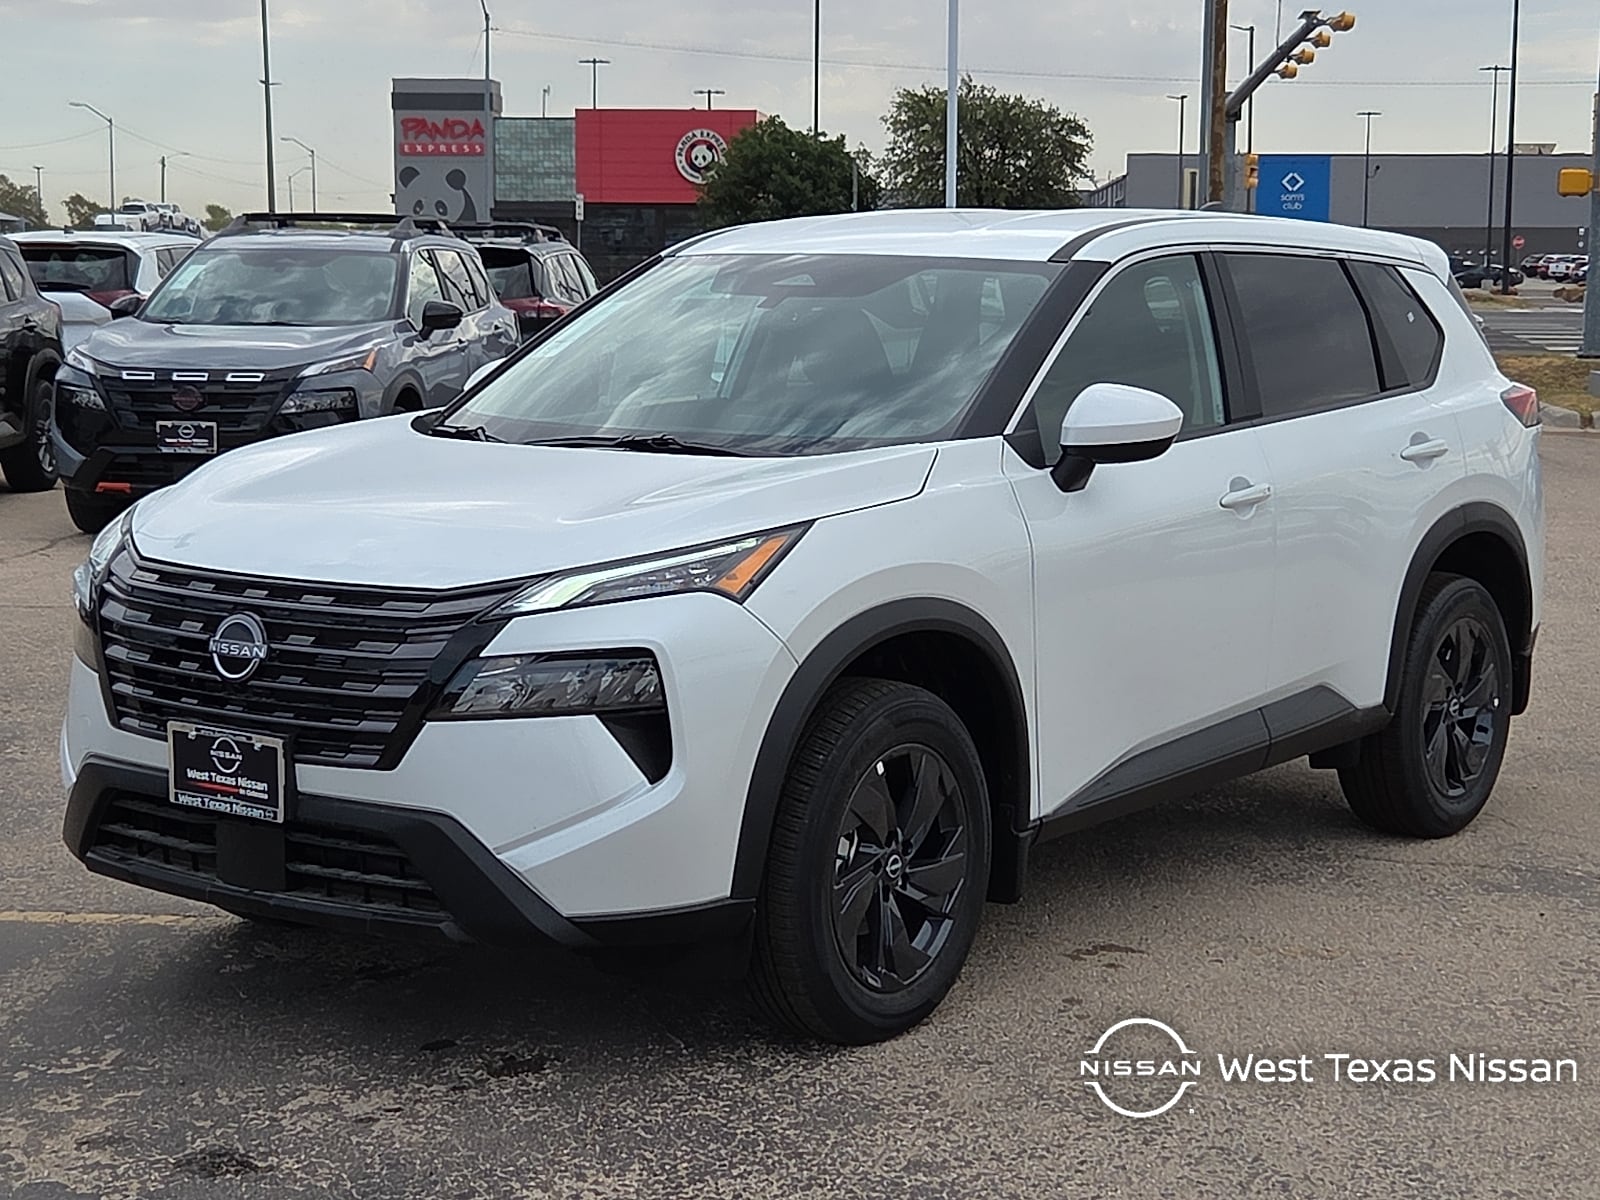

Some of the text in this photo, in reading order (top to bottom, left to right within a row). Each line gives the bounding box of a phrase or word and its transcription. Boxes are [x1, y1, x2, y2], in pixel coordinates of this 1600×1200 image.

[400, 117, 485, 141] PANDA
[403, 144, 482, 153] EXPRESS
[1282, 202, 1303, 210] club
[210, 638, 267, 659] NISSAN
[210, 749, 243, 761] NISSAN
[186, 768, 268, 792] West Texas Nissan
[178, 793, 265, 819] West Texas Nissan
